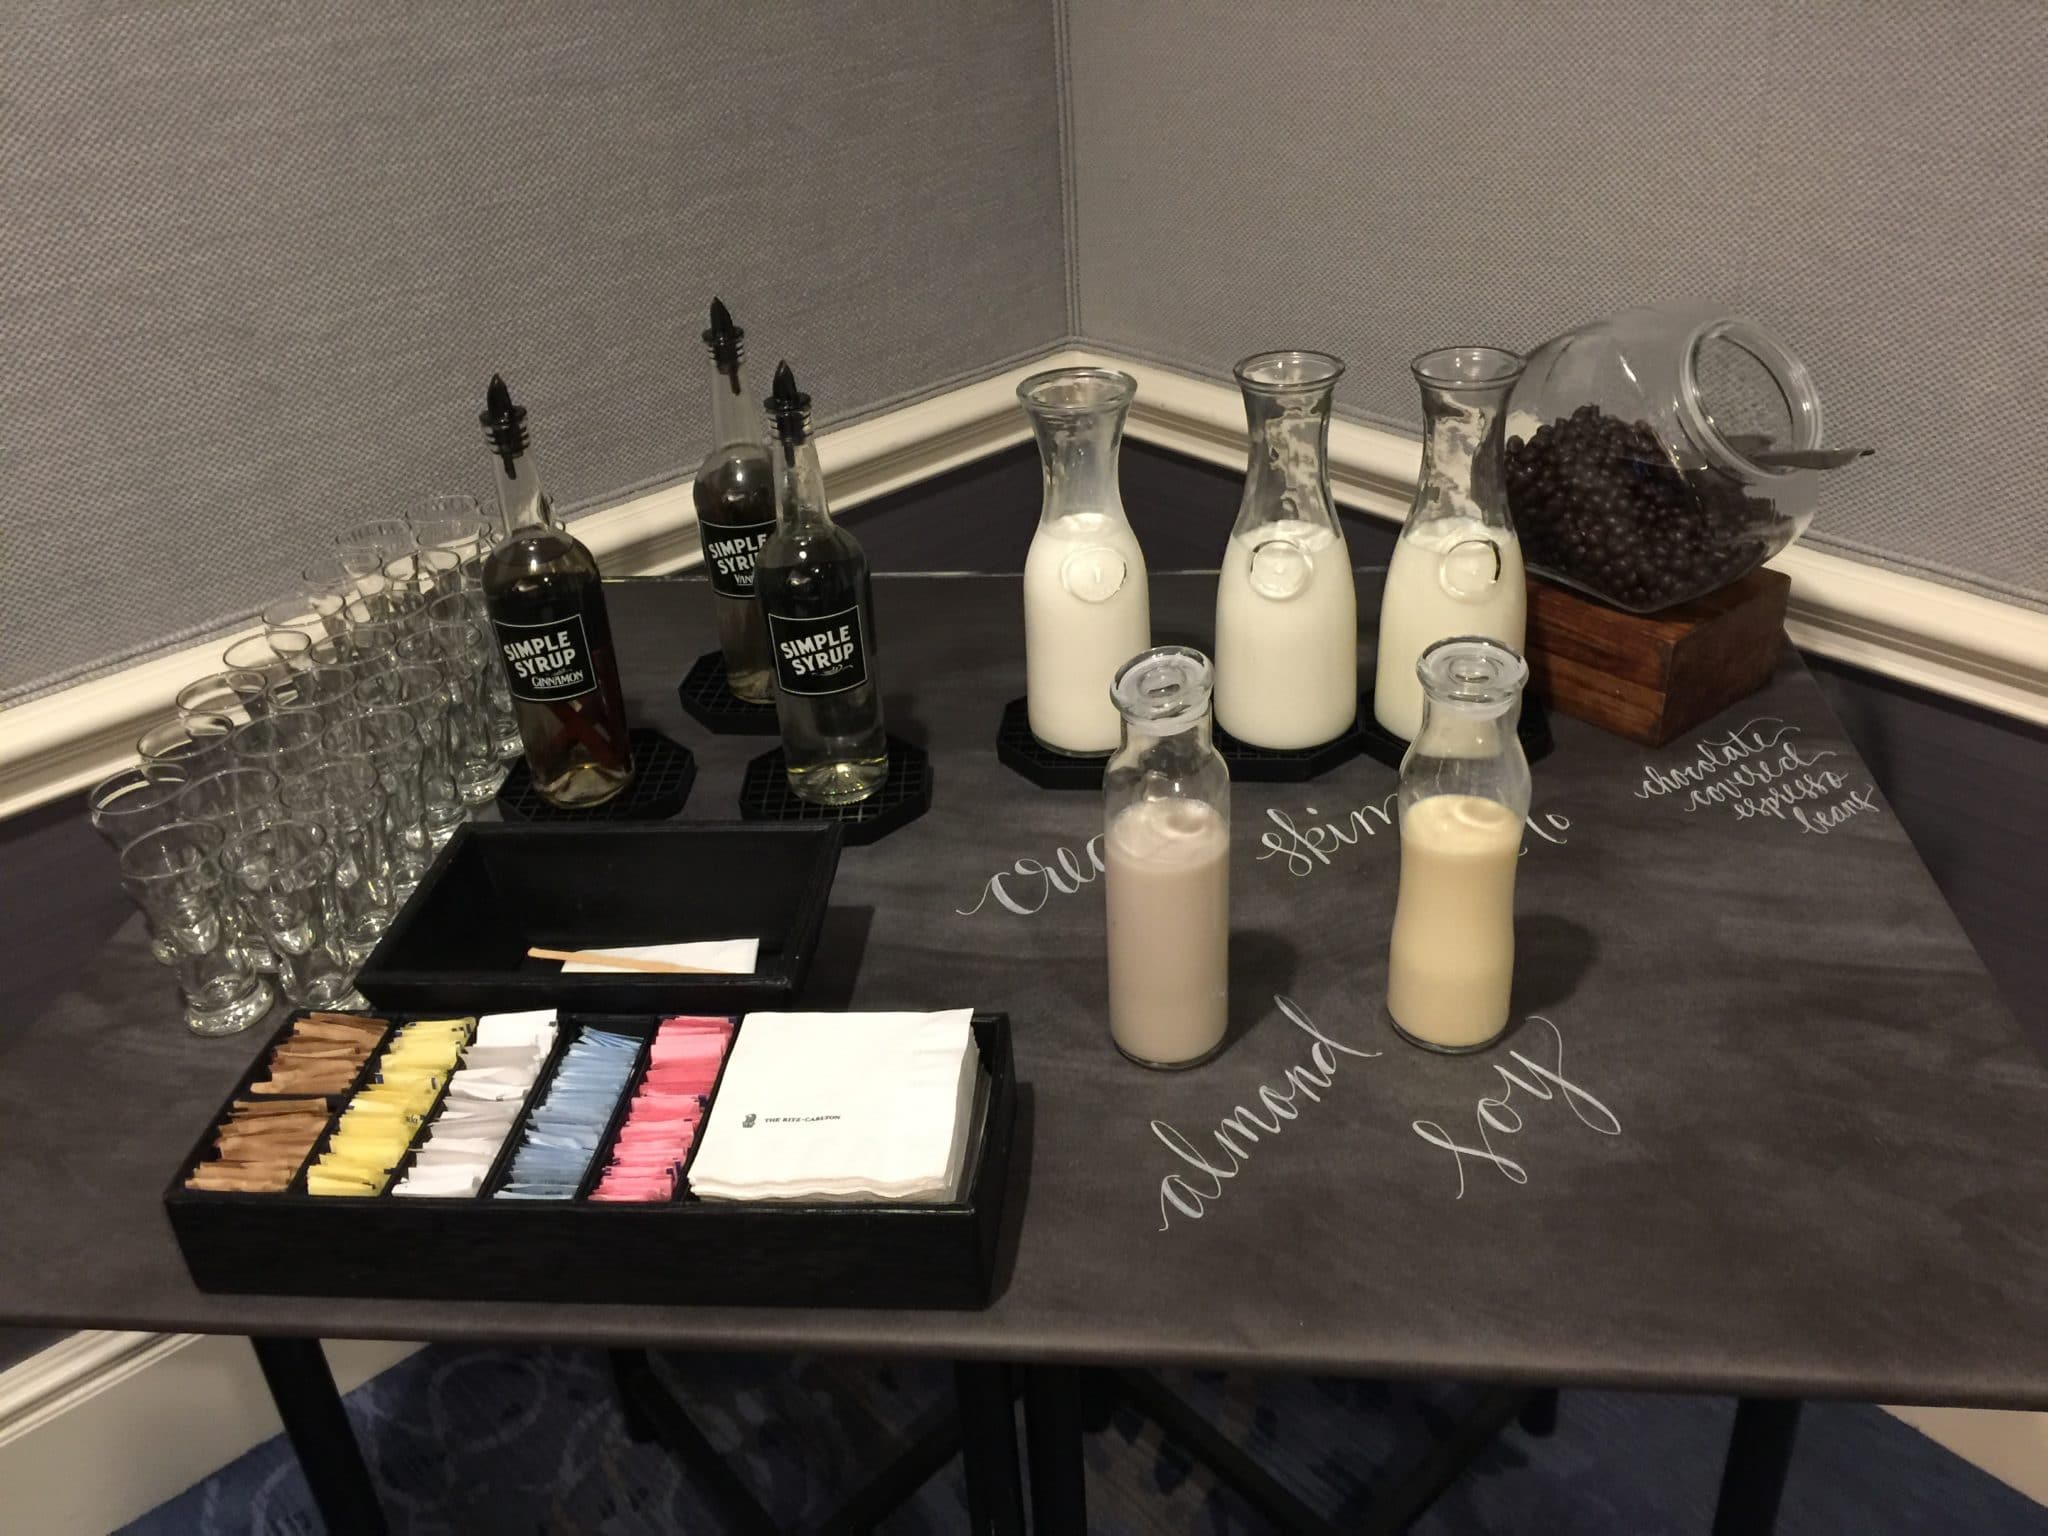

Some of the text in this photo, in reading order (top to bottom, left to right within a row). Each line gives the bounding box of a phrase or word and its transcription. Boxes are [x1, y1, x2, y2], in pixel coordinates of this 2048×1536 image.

[708, 533, 767, 559] SIMPLE
[717, 552, 759, 575] SYRU
[503, 631, 571, 661] SIMPLE
[514, 648, 576, 678] SYRUP
[780, 625, 851, 659] SIMPLE
[791, 642, 854, 675] SYRUP
[531, 669, 584, 688] CINNAMON
[1634, 717, 1800, 799] chocolate
[1684, 742, 1837, 811] covered
[1734, 770, 1849, 820] espresso
[1793, 783, 1880, 834] beans
[1256, 793, 1398, 876] skim
[1151, 994, 1383, 1231] almond
[1412, 1015, 1622, 1200] soy
